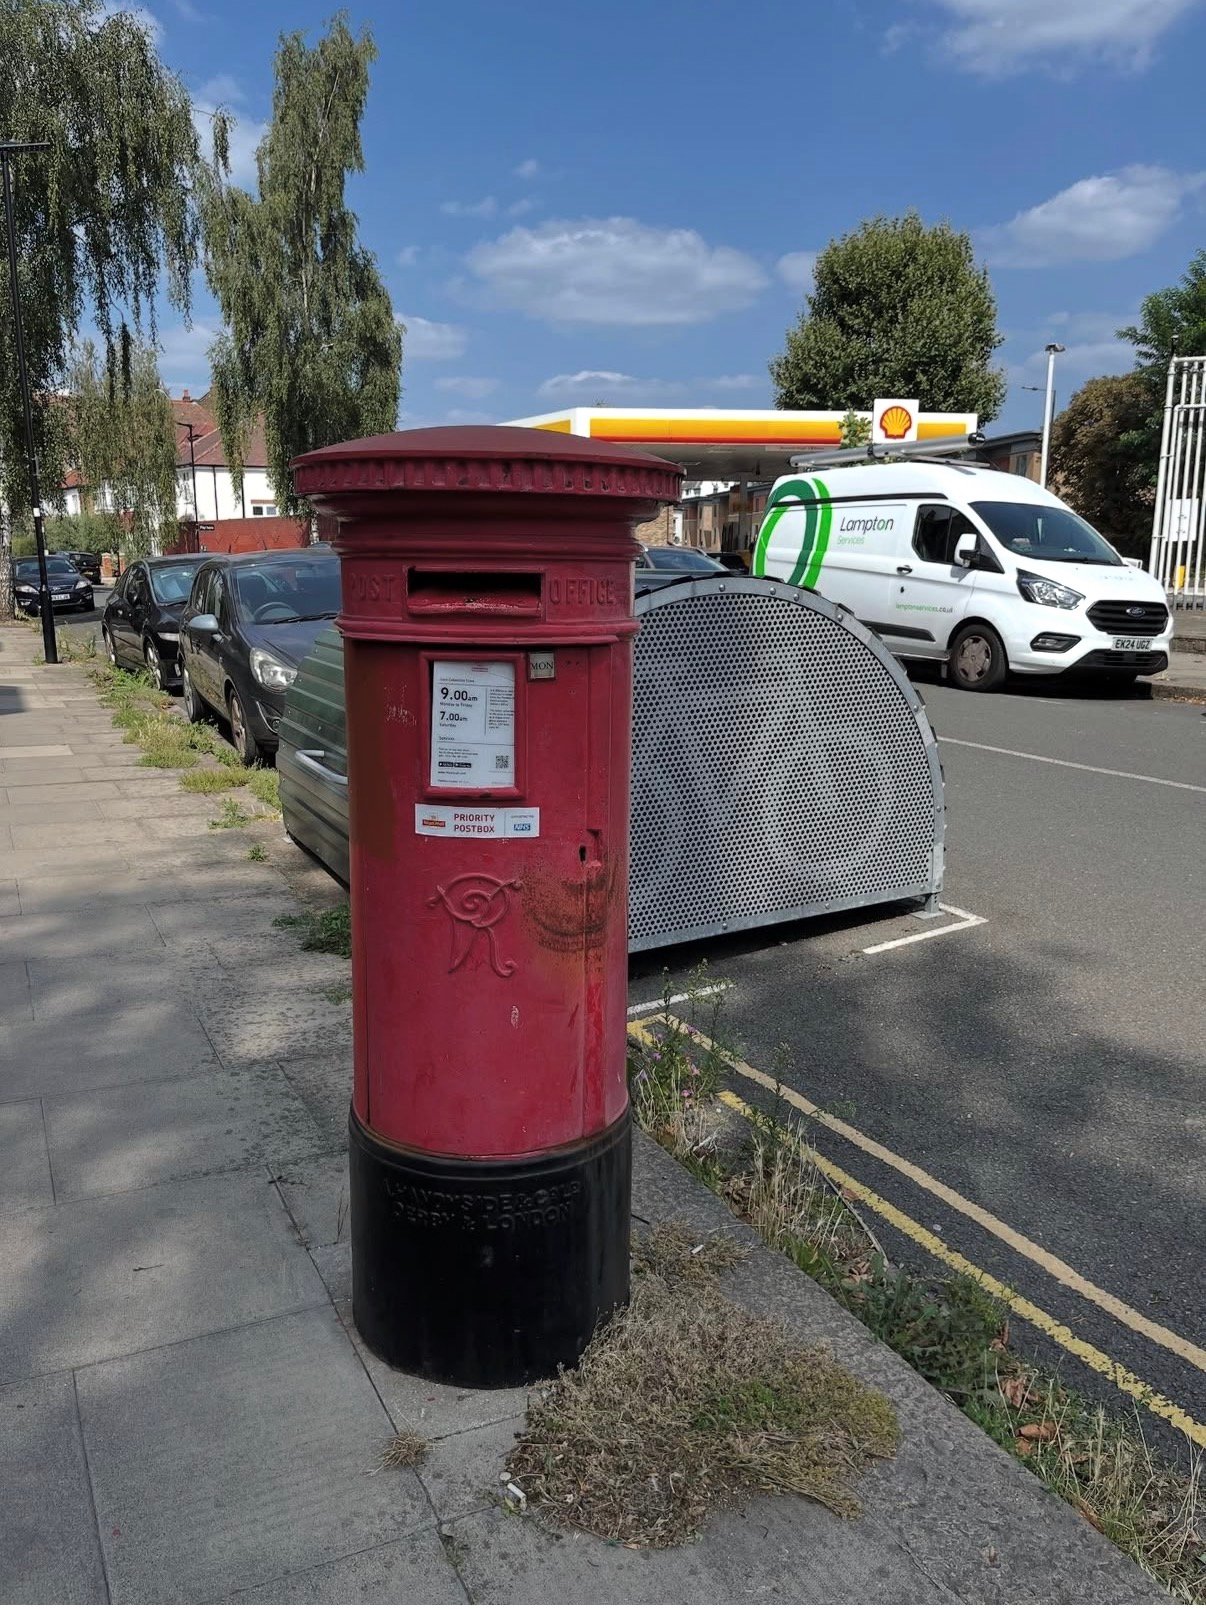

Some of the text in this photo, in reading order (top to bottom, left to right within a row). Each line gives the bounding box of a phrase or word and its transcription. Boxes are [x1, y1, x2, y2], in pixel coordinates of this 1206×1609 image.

[840, 516, 895, 535] Lampton
[837, 535, 865, 545] Services
[548, 576, 615, 605] OFFICE
[1115, 639, 1135, 649] EK24
[531, 661, 553, 670] MON
[440, 687, 478, 701] 9.00am
[440, 711, 468, 722] 7.00am
[454, 813, 495, 822] PRIORITY
[454, 824, 495, 833] POSTBOX
